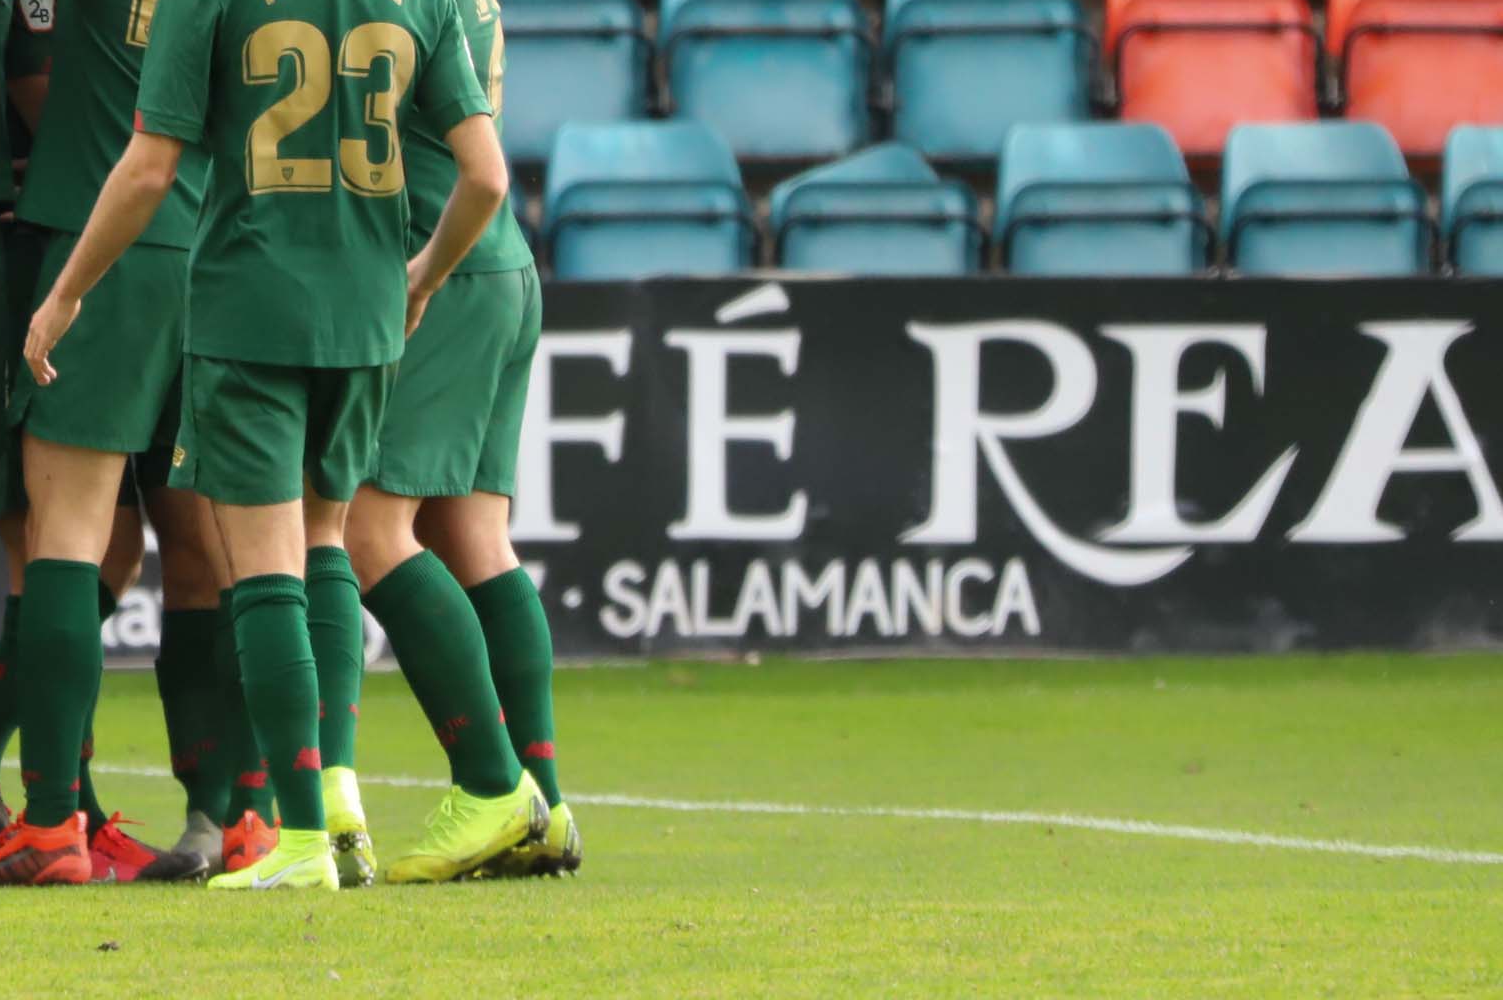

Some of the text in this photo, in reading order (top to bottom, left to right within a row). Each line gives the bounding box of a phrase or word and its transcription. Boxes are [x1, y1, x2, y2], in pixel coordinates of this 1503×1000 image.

[242, 20, 416, 197] 23
[898, 319, 1503, 587] REA
[598, 557, 1042, 638] SALAMANCA
